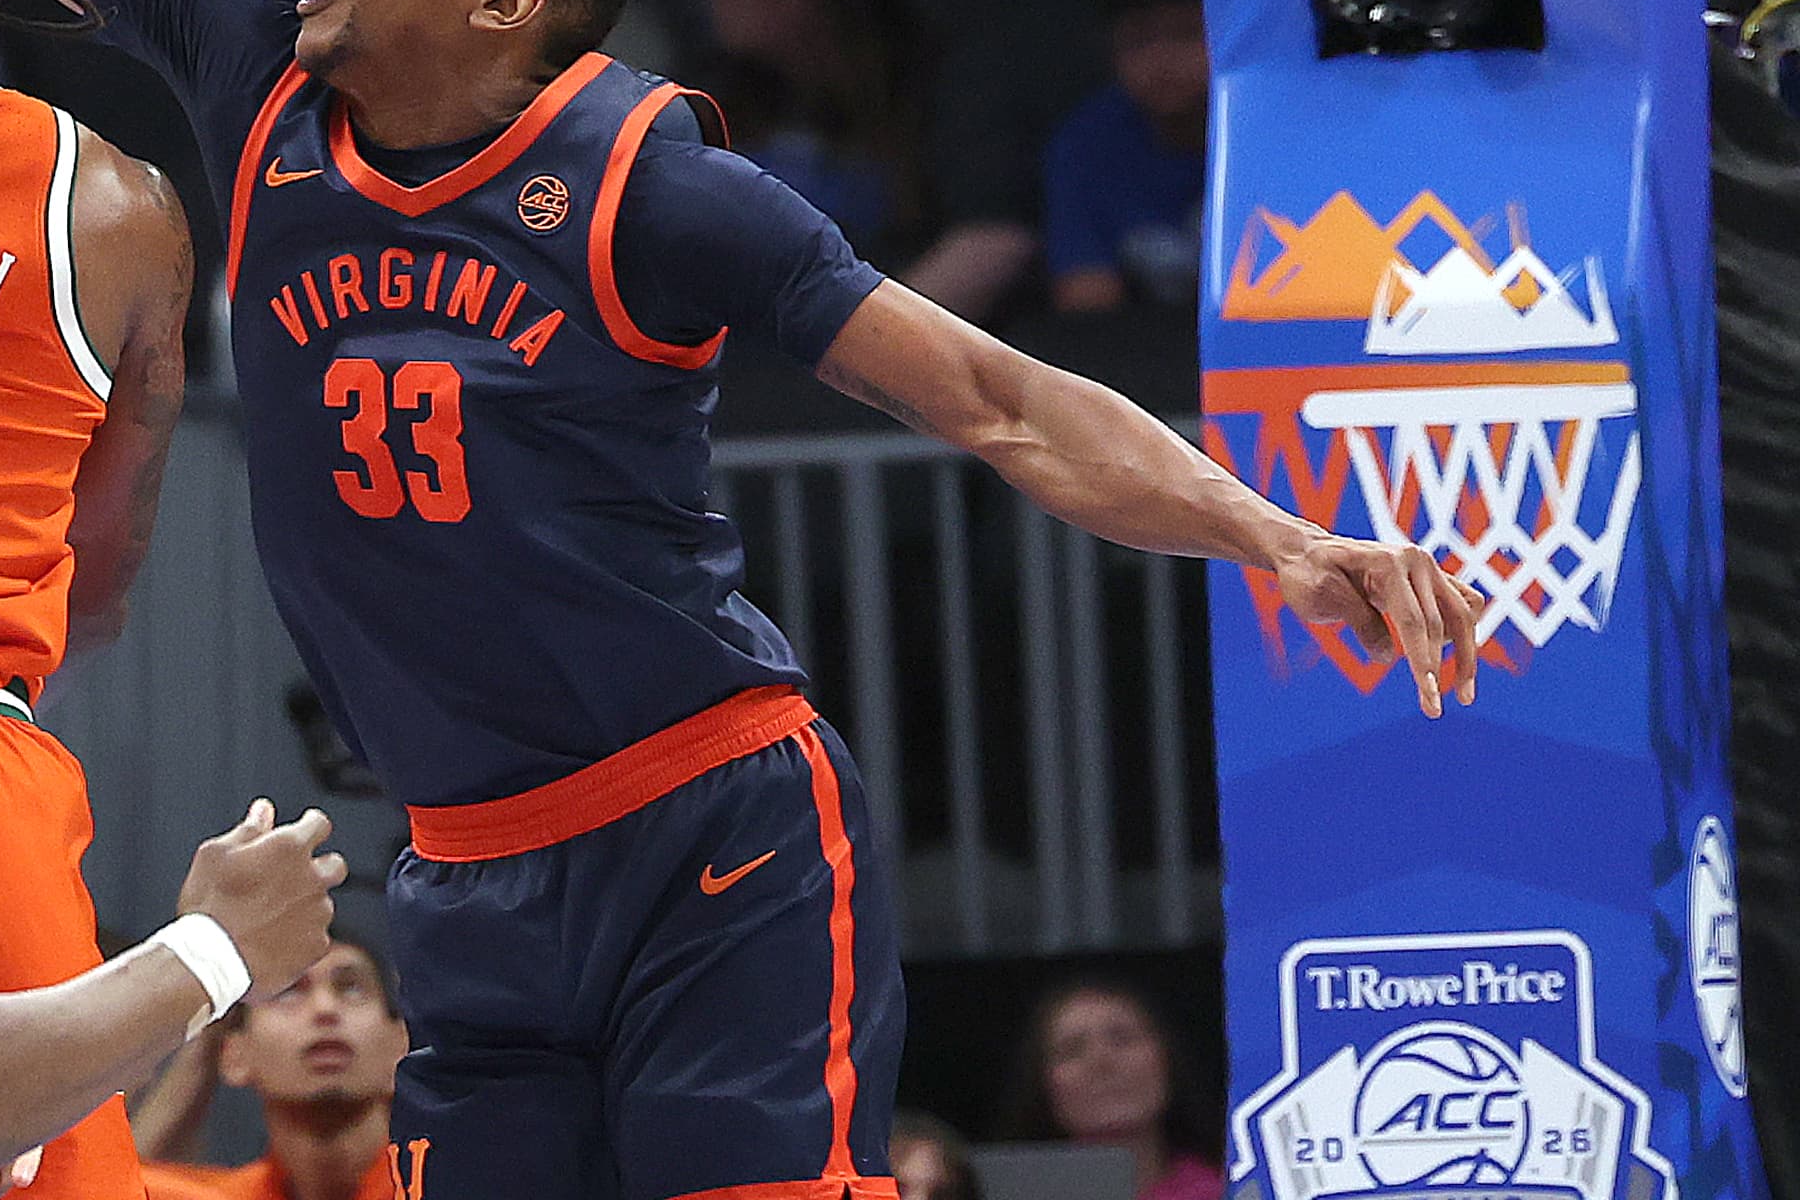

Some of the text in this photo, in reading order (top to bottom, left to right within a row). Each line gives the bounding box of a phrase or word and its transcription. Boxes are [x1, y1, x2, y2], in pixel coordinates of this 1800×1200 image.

[270, 247, 567, 368] VIRGINIA
[323, 358, 472, 523] 33
[1297, 1128, 1591, 1163] 20 26
[1375, 1089, 1522, 1133] ACC
